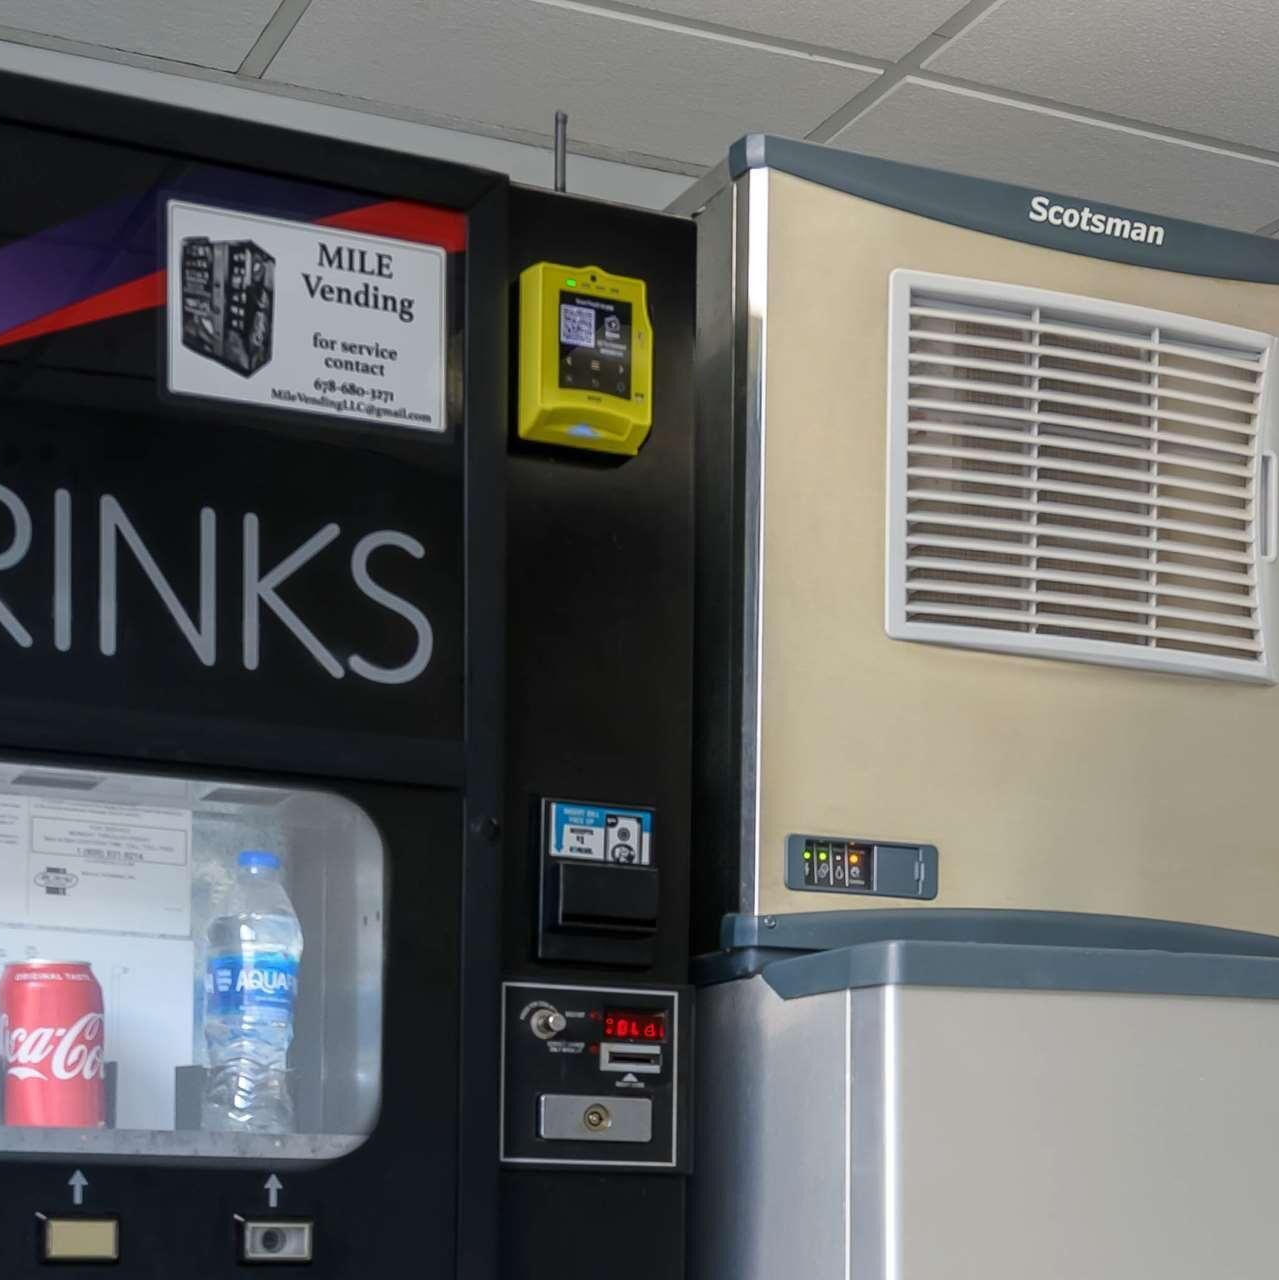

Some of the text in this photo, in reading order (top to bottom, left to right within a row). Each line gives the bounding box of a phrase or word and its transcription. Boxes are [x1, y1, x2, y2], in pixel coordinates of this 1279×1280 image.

[1029, 196, 1165, 247] Scotsman
[318, 243, 394, 279] MILE
[301, 273, 415, 323] Vending
[313, 332, 398, 361] for service
[324, 355, 385, 377] contact
